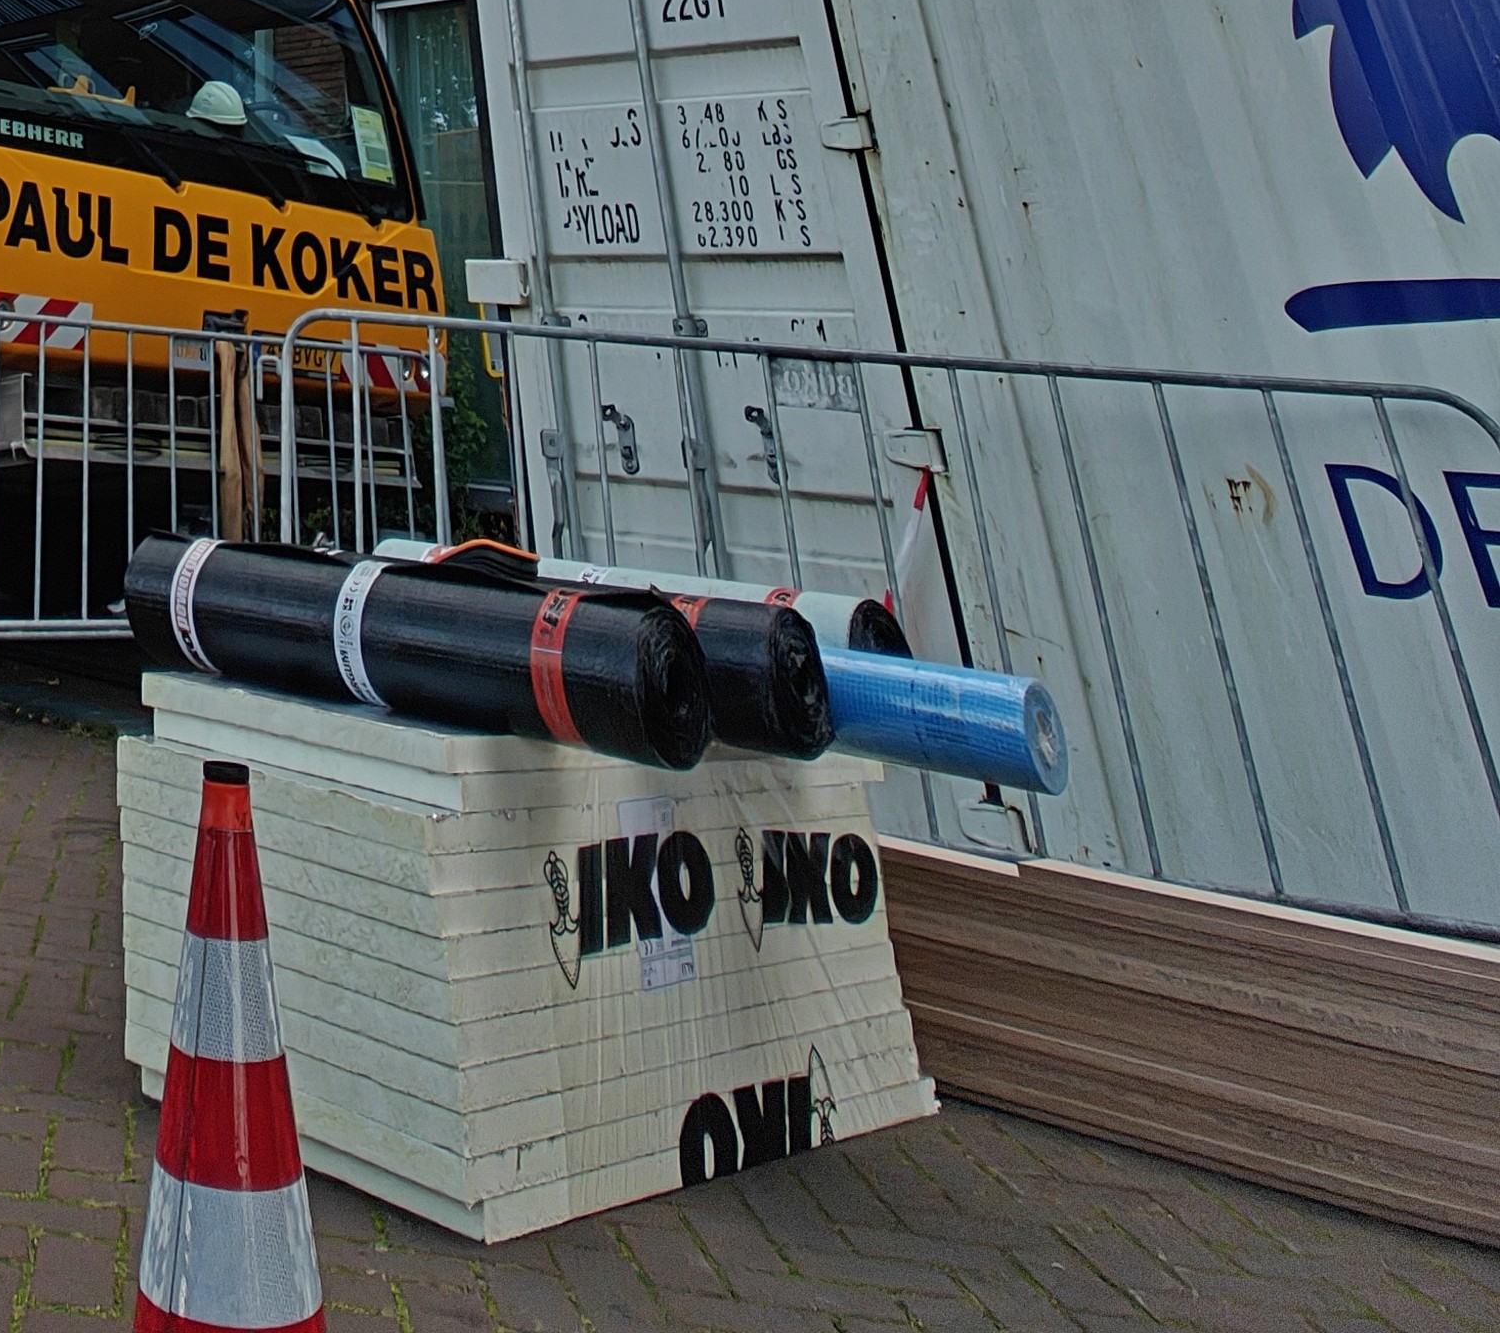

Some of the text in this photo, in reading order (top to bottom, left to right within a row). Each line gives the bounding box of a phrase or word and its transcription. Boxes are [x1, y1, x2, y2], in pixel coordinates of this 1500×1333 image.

[153, 206, 231, 283] DE
[250, 222, 439, 314] KOKER
[692, 200, 754, 223] 28.300
[577, 829, 716, 958] IKO
[761, 829, 879, 926] IKO
